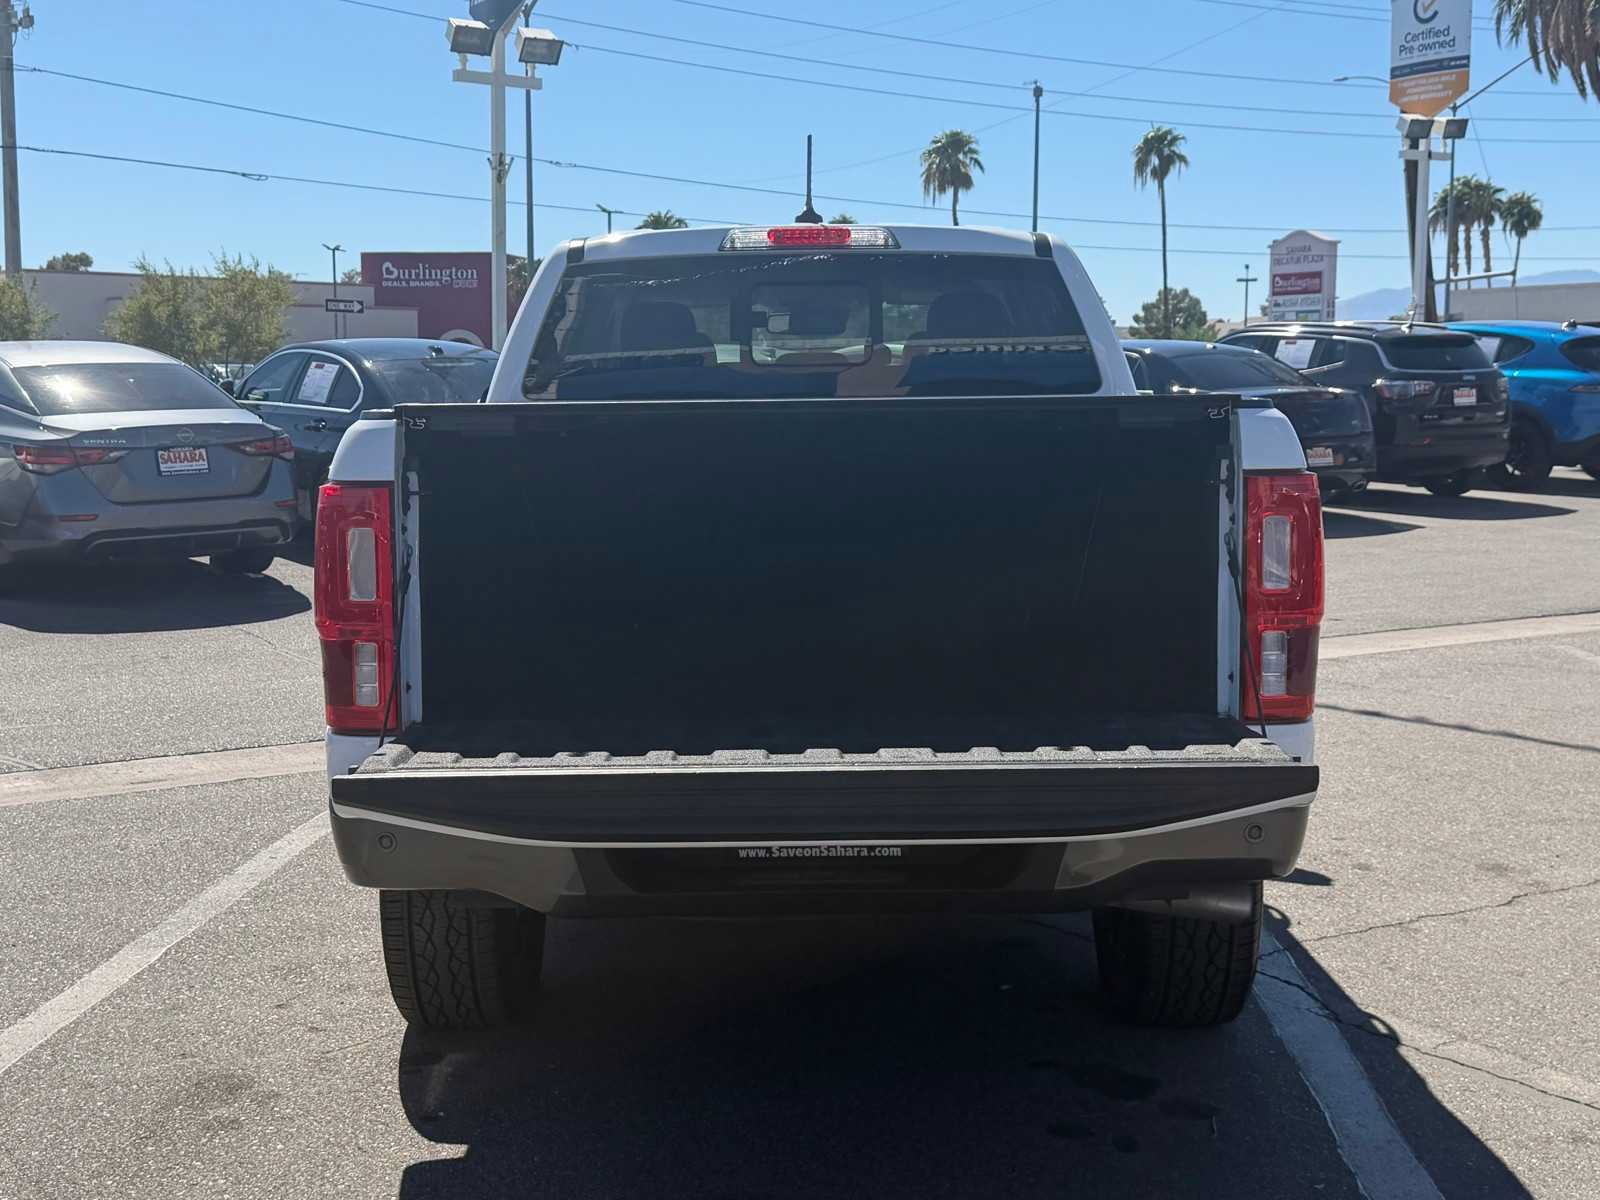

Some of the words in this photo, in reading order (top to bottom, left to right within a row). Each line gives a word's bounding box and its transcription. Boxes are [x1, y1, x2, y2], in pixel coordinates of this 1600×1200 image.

[1404, 25, 1451, 44] Certified
[382, 261, 478, 285] Burlington
[160, 451, 206, 464] SAHARA
[738, 846, 902, 858] www.SaveonSahara.com
